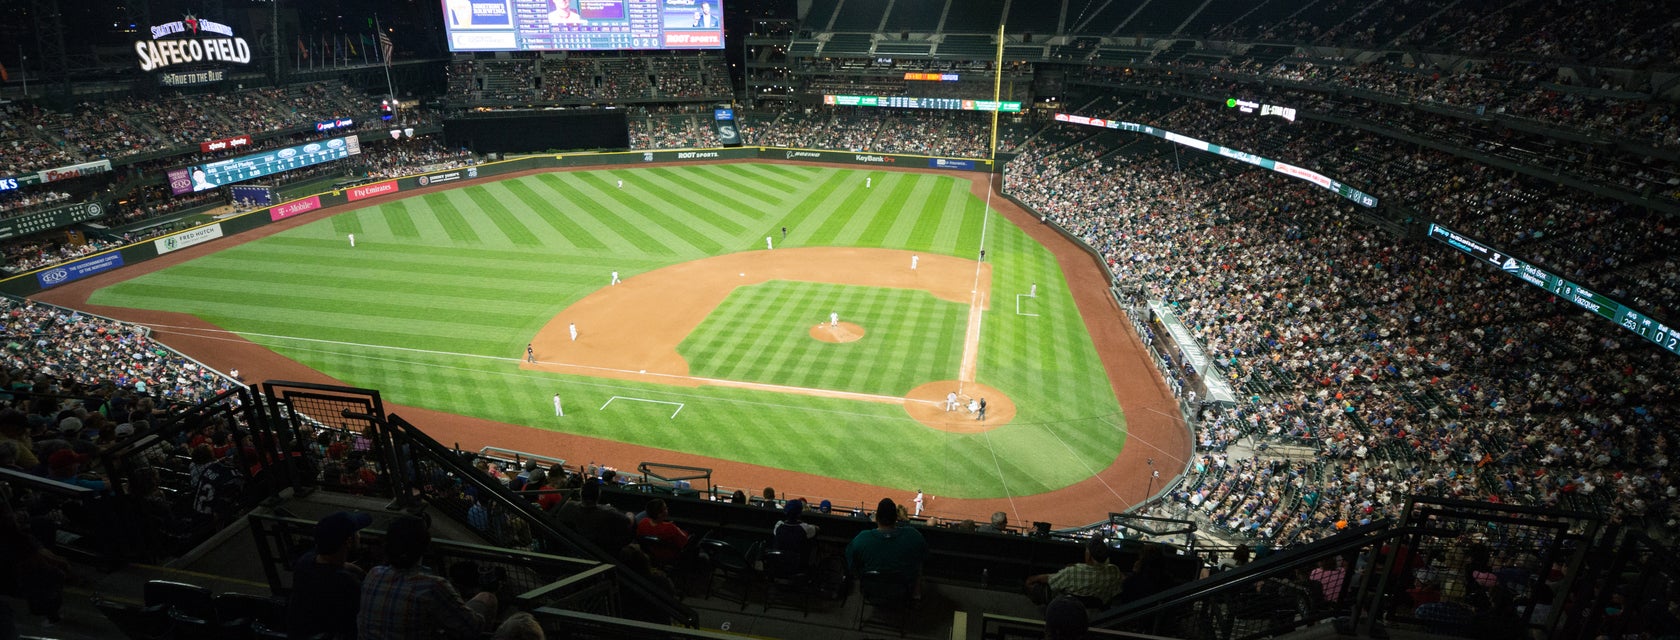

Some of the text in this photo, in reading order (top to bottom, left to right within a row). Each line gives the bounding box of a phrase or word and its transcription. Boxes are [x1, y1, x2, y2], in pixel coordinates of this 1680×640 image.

[136, 38, 250, 71] SAFECO FIELD
[366, 185, 391, 194] Emirates
[196, 228, 214, 238] HUTCH
[1525, 265, 1536, 275] Red
[1536, 269, 1546, 279] Sox
[1522, 272, 1544, 287] Mariners
[1573, 294, 1600, 312] Vazquez
[1623, 318, 1636, 330] 253
[1656, 332, 1663, 342] 0
[1668, 338, 1677, 350] 2
[720, 622, 730, 631] 6
